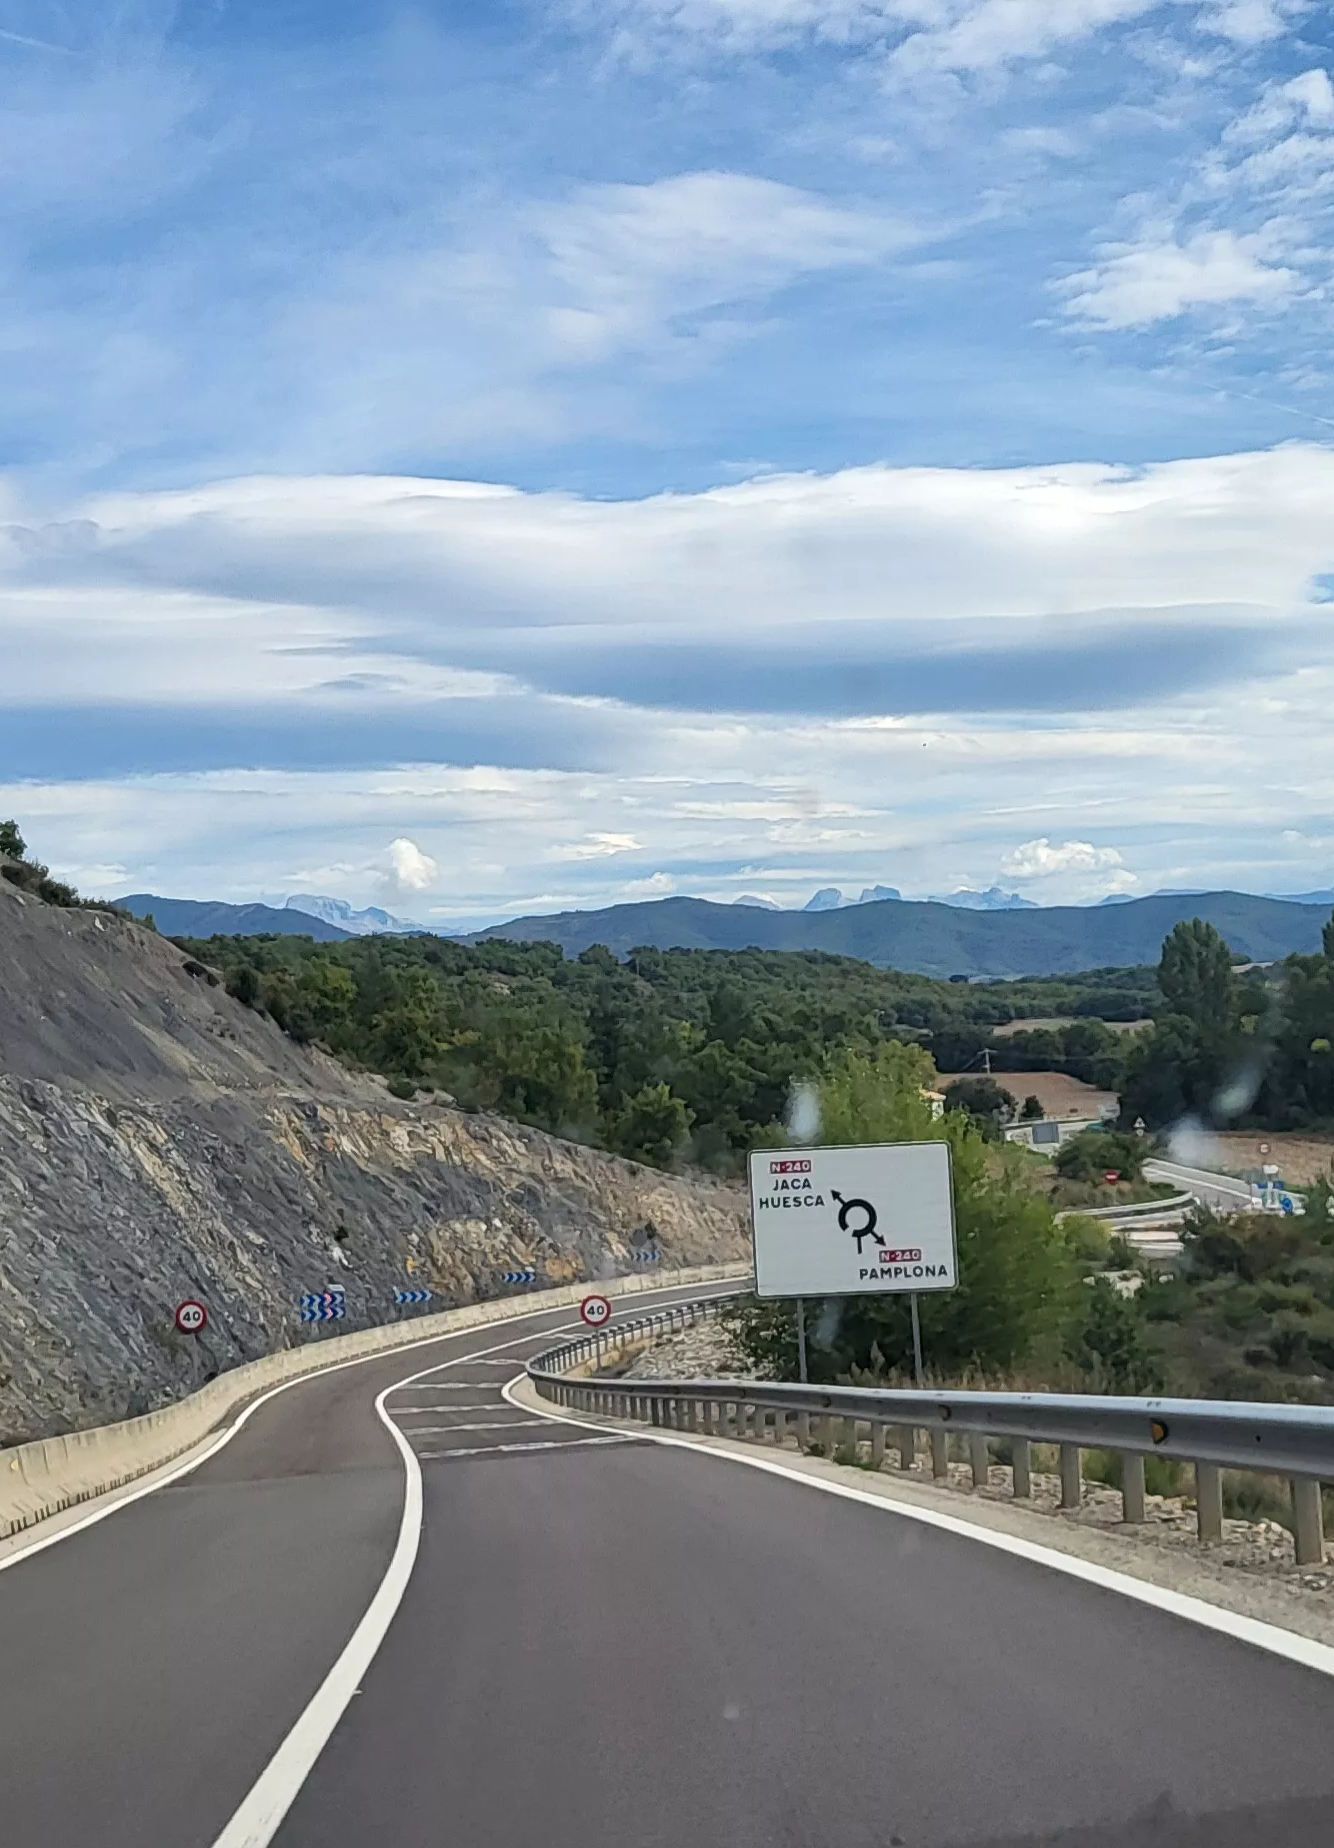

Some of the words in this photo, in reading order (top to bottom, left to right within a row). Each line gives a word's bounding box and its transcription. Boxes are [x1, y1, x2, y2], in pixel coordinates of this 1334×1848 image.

[773, 1178, 812, 1191] JACA
[759, 1195, 825, 1209] HUESCA
[859, 1265, 948, 1280] PAMPLONA
[183, 1311, 201, 1322] 40
[587, 1305, 605, 1315] 40
